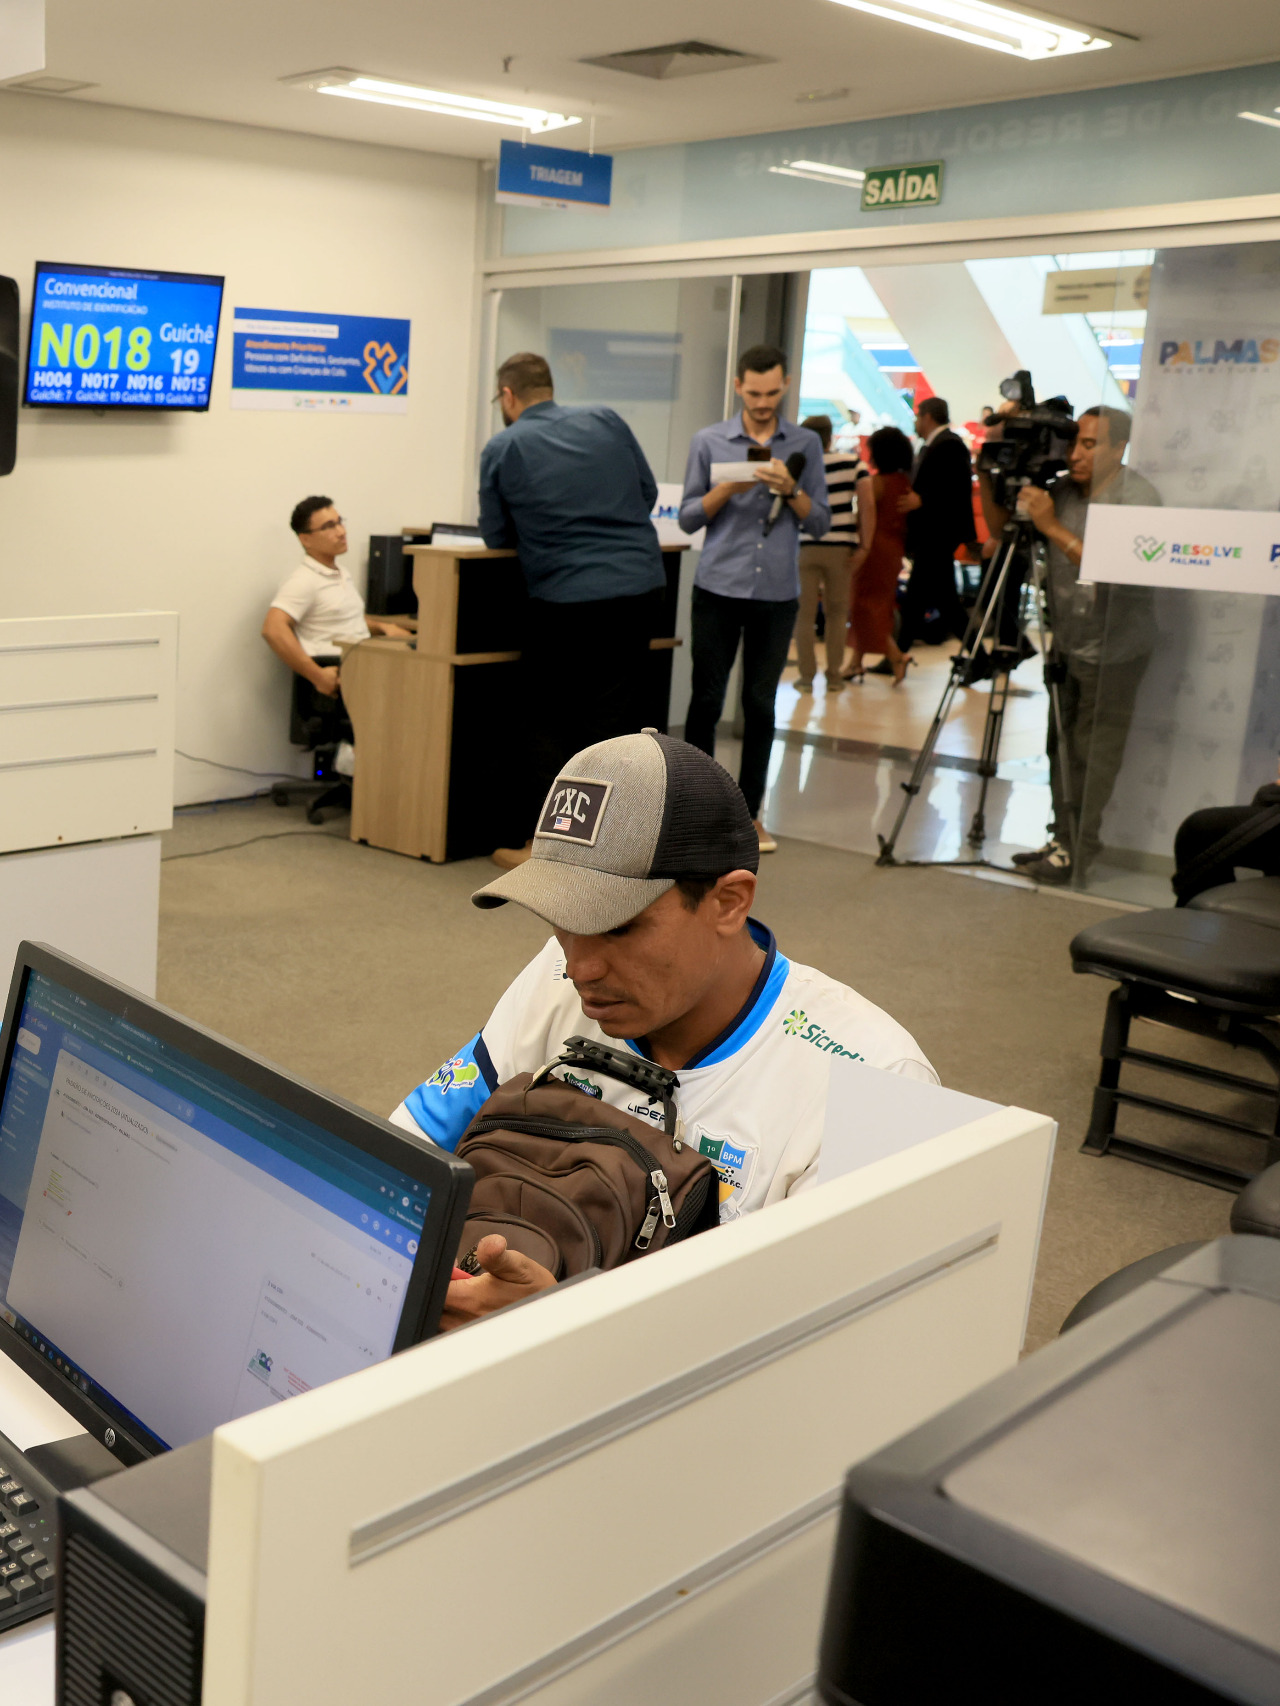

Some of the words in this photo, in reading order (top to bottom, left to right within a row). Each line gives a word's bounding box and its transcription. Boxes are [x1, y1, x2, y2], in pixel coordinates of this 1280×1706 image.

[529, 164, 583, 187] TRIAGEM
[864, 170, 937, 204] SAÍDA
[45, 278, 138, 300] Convencional
[38, 322, 152, 371] N018
[159, 322, 214, 344] Guichê
[1159, 338, 1280, 365] PALMAS
[170, 348, 200, 375] 19
[33, 371, 72, 388] H004
[81, 372, 119, 389] N017
[126, 373, 163, 391] N016
[171, 375, 206, 392] N015
[1170, 557, 1210, 566] PALMAS
[1171, 544, 1243, 558] RESOLVE
[550, 788, 591, 824] TXC
[722, 1151, 742, 1165] BPM
